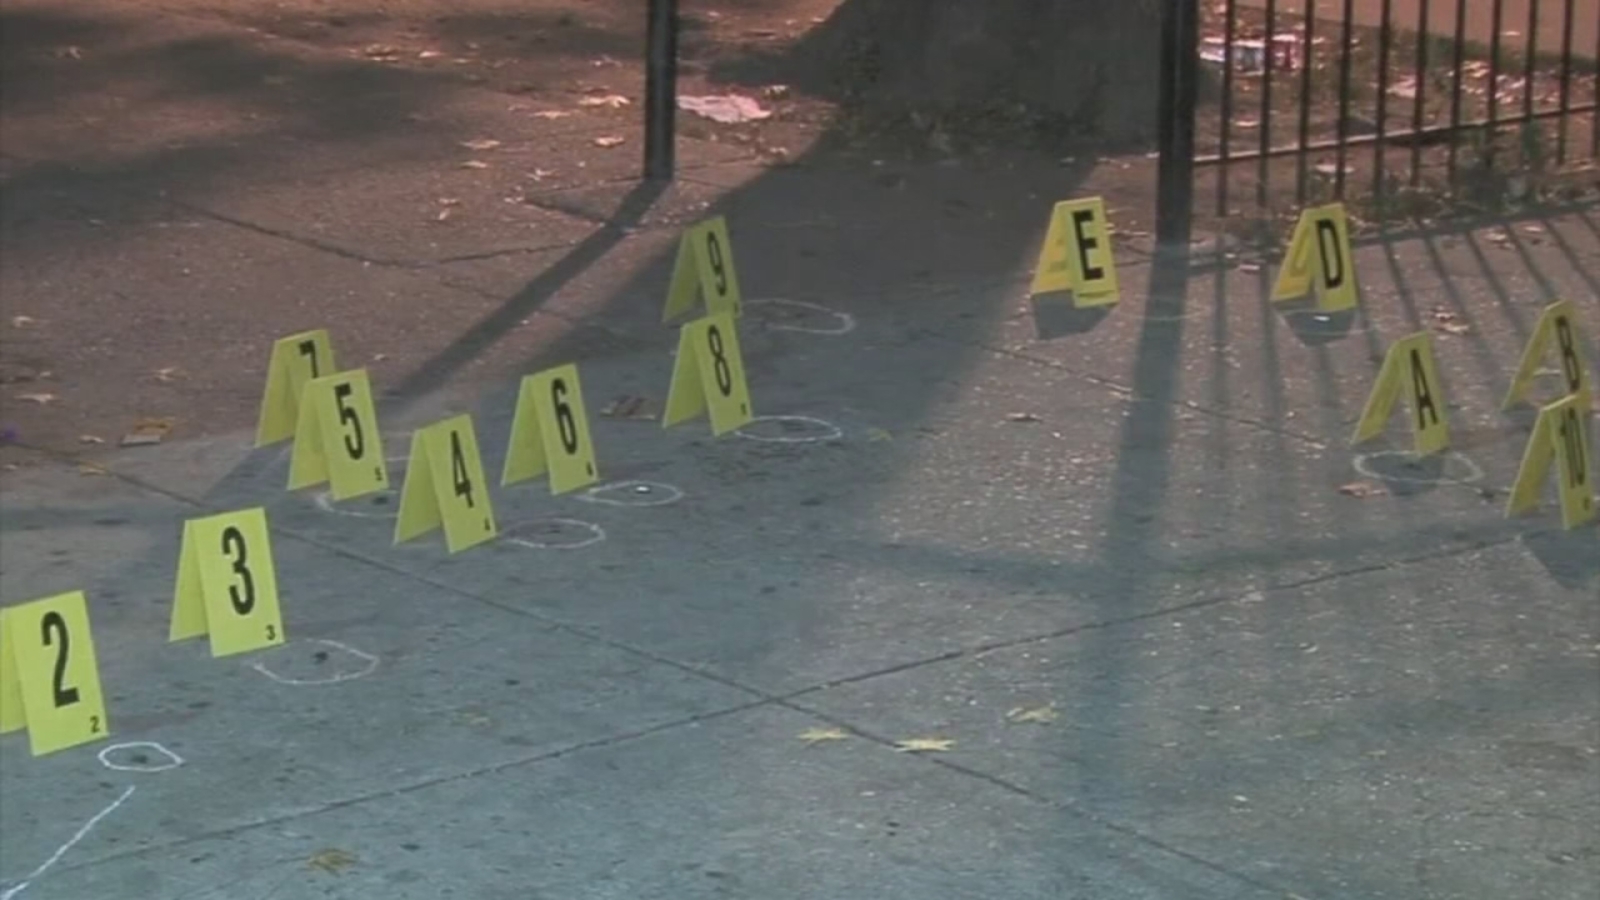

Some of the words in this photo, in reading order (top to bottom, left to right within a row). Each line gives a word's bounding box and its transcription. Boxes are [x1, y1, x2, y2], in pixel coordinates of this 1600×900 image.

[707, 231, 726, 296] 9
[1072, 210, 1104, 280] E
[1316, 218, 1343, 289] D
[299, 340, 318, 378] 7
[708, 325, 730, 397] 8
[1410, 349, 1438, 430] A
[1555, 315, 1580, 394] B
[334, 383, 363, 460] 5
[551, 378, 577, 455] 6
[1559, 408, 1585, 488] 10
[451, 430, 474, 508] 4
[222, 526, 255, 615] 3
[41, 611, 80, 708] 2
[266, 624, 276, 641] 3
[90, 716, 100, 733] 2
